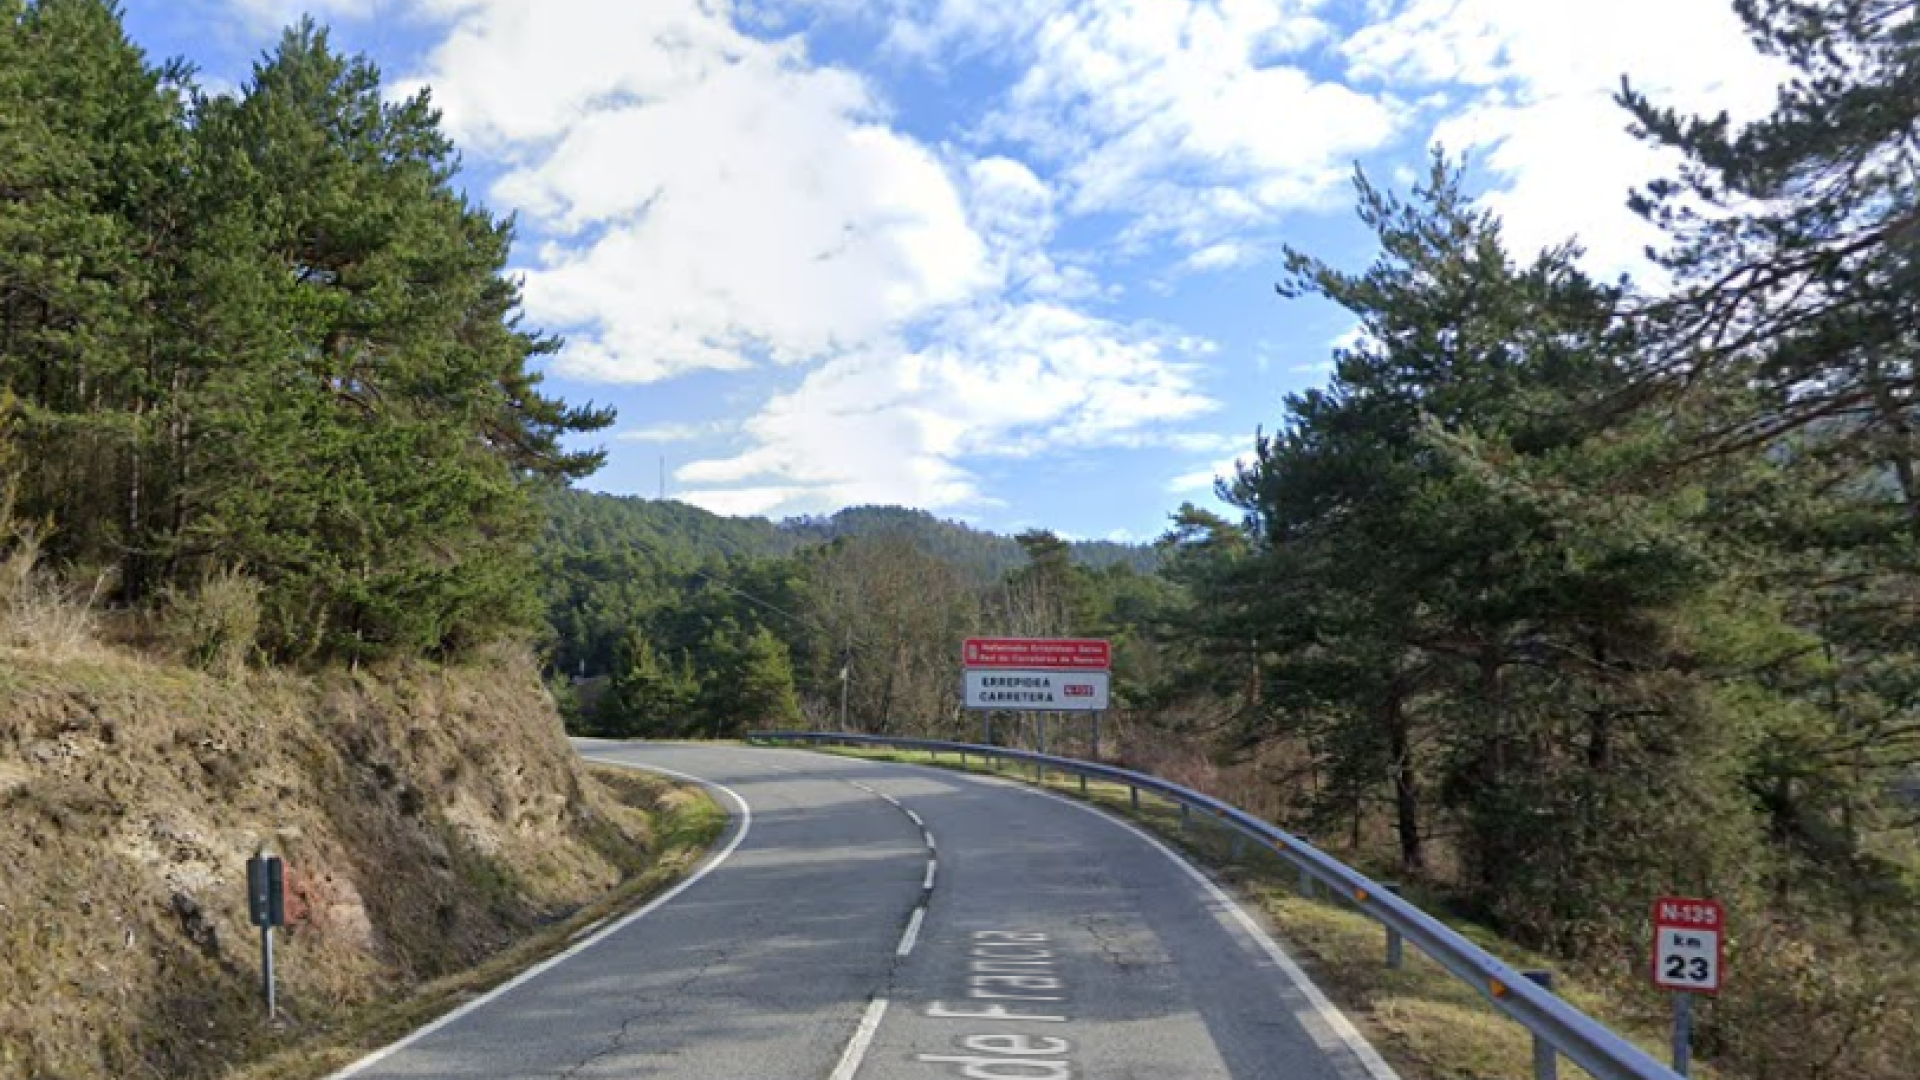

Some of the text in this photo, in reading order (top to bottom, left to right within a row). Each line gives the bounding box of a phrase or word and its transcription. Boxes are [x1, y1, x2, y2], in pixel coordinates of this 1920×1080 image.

[981, 677, 1051, 687] ERREPIDEA
[979, 691, 1055, 702] CARRETERA
[1660, 902, 1718, 924] N-135
[1673, 932, 1702, 947] km
[1665, 954, 1710, 982] 23
